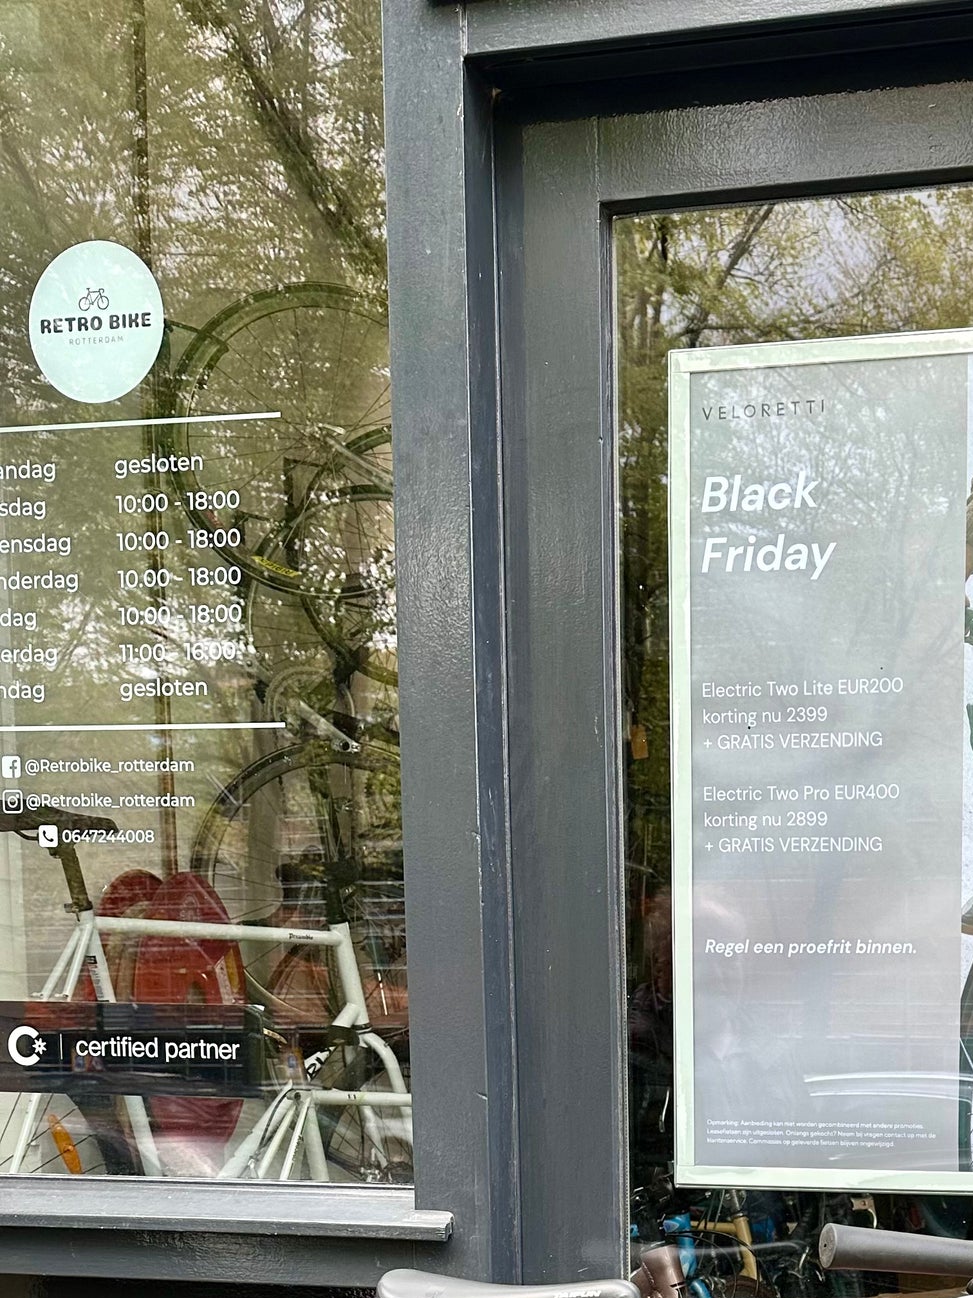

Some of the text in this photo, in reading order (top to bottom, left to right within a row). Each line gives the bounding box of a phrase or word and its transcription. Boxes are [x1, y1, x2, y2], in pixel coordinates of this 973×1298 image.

[40, 312, 152, 335] RETRO BIKE
[69, 336, 124, 346] ROTTERDAM
[702, 399, 825, 421] VELORETTI
[114, 453, 203, 479] gesloten
[116, 493, 169, 514] 10:00
[187, 490, 240, 511] 18:00
[701, 471, 820, 513] Black
[117, 532, 169, 551] 10:00
[188, 528, 241, 549] 18:00
[701, 534, 837, 580] Friday
[188, 566, 241, 587] 18:00
[118, 606, 170, 626] 10:00
[189, 603, 242, 624] 18:00
[0, 645, 58, 668] erdag
[119, 643, 165, 662] 11:00
[185, 641, 236, 661] 16:00
[120, 678, 208, 701] gesloten
[702, 677, 904, 697] Electric Two Lite EUR200
[702, 707, 828, 728] korting nu 2399
[717, 733, 775, 749] GRATIS
[779, 731, 883, 748] VERZENDING
[25, 758, 195, 774] @Retrobike_rotterdam
[26, 793, 196, 809] @Retrobike_rotterdam
[703, 783, 900, 801] Electric Two Pro EUR400
[704, 811, 828, 830] korting nu 2899
[62, 830, 155, 843] 0647244008
[718, 836, 775, 852] GRATIS
[779, 836, 883, 851] VERZENDING
[704, 938, 917, 957] Regel een proefrit binnen.
[75, 1037, 240, 1062] certified partner
